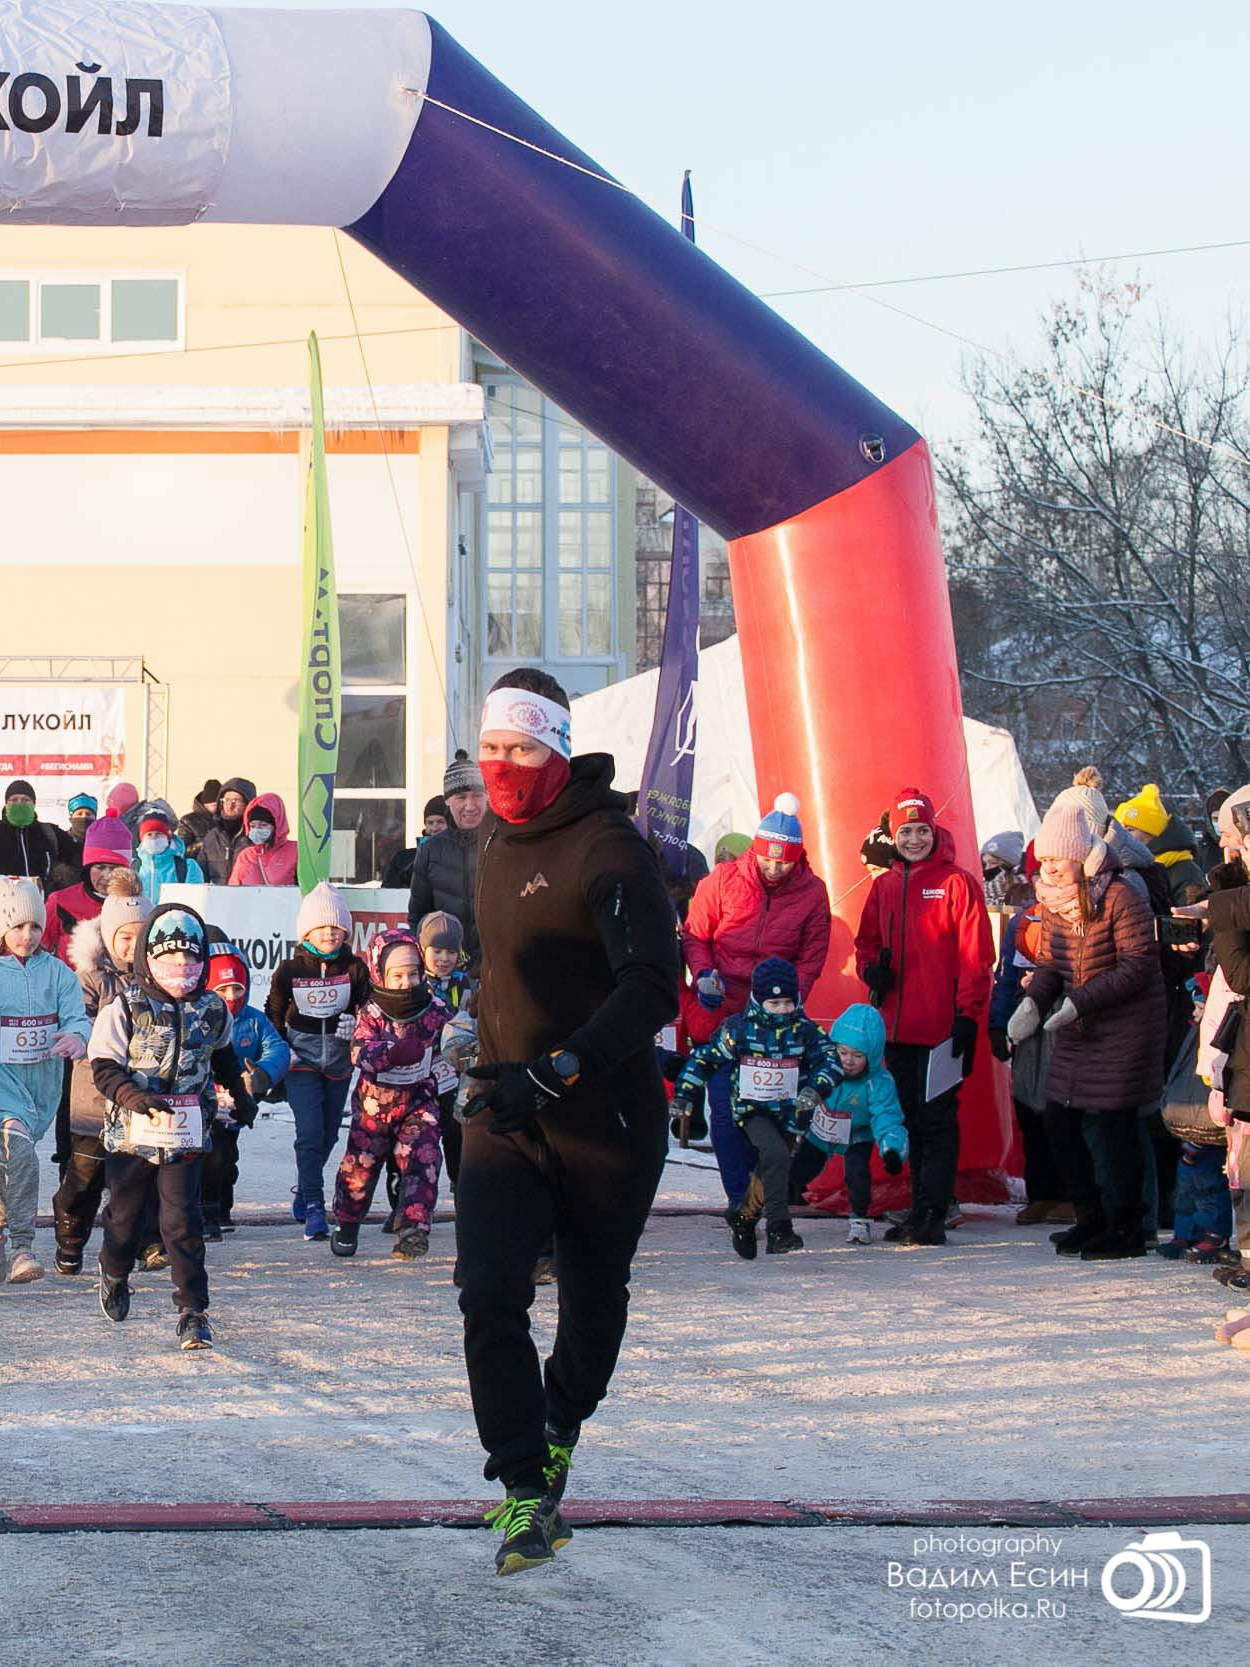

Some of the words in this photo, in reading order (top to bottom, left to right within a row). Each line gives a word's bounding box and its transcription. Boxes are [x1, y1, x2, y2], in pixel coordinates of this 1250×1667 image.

[2, 710, 91, 730] ЛУКОЙЛ
[307, 988, 338, 1004] 629
[21, 1019, 37, 1027] 600
[15, 1029, 47, 1047] 633
[752, 1070, 784, 1087] 622
[149, 1110, 188, 1128] 612
